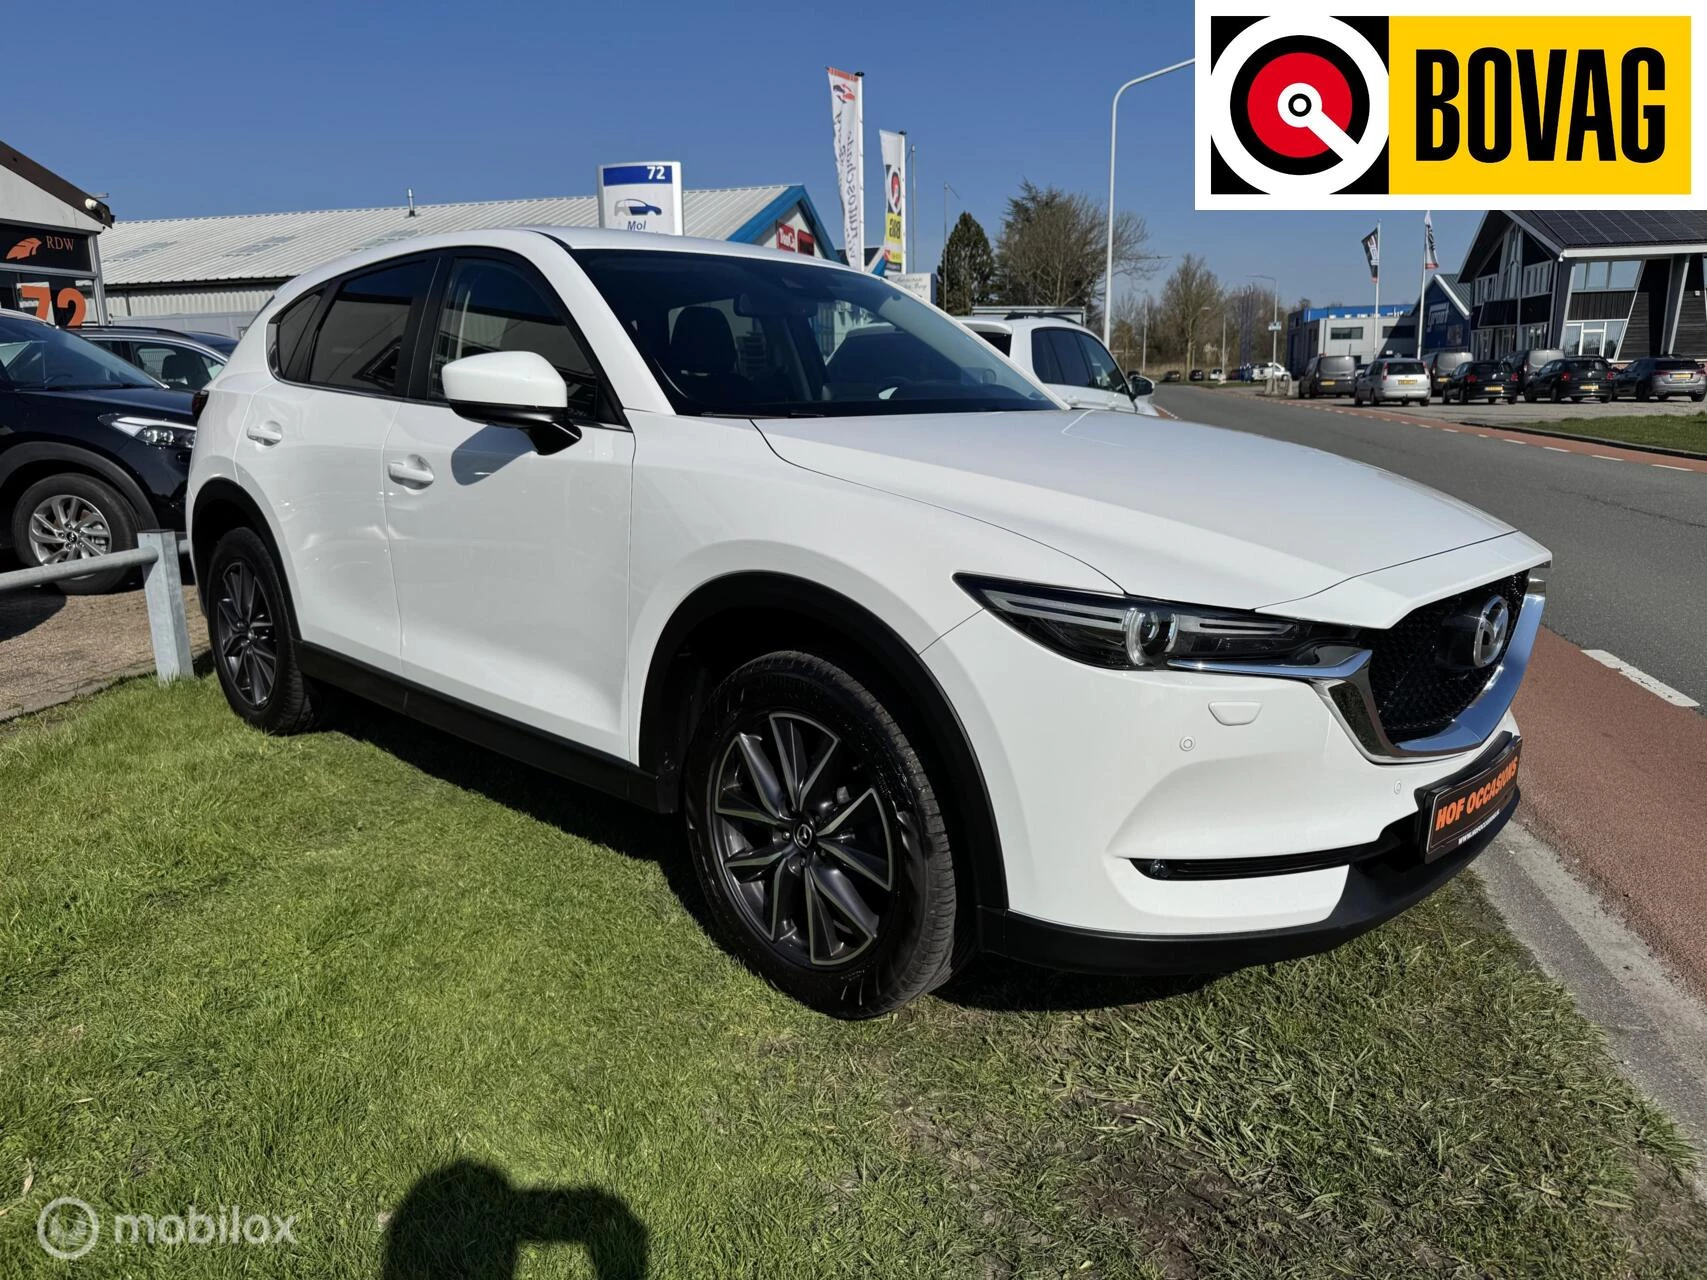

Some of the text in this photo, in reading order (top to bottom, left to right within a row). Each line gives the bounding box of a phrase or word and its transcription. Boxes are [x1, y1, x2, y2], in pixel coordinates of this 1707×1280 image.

[646, 166, 666, 180] 72
[627, 220, 647, 231] Mol
[46, 235, 75, 251] RDW
[20, 285, 87, 327] 72
[1435, 798, 1466, 831] HOF
